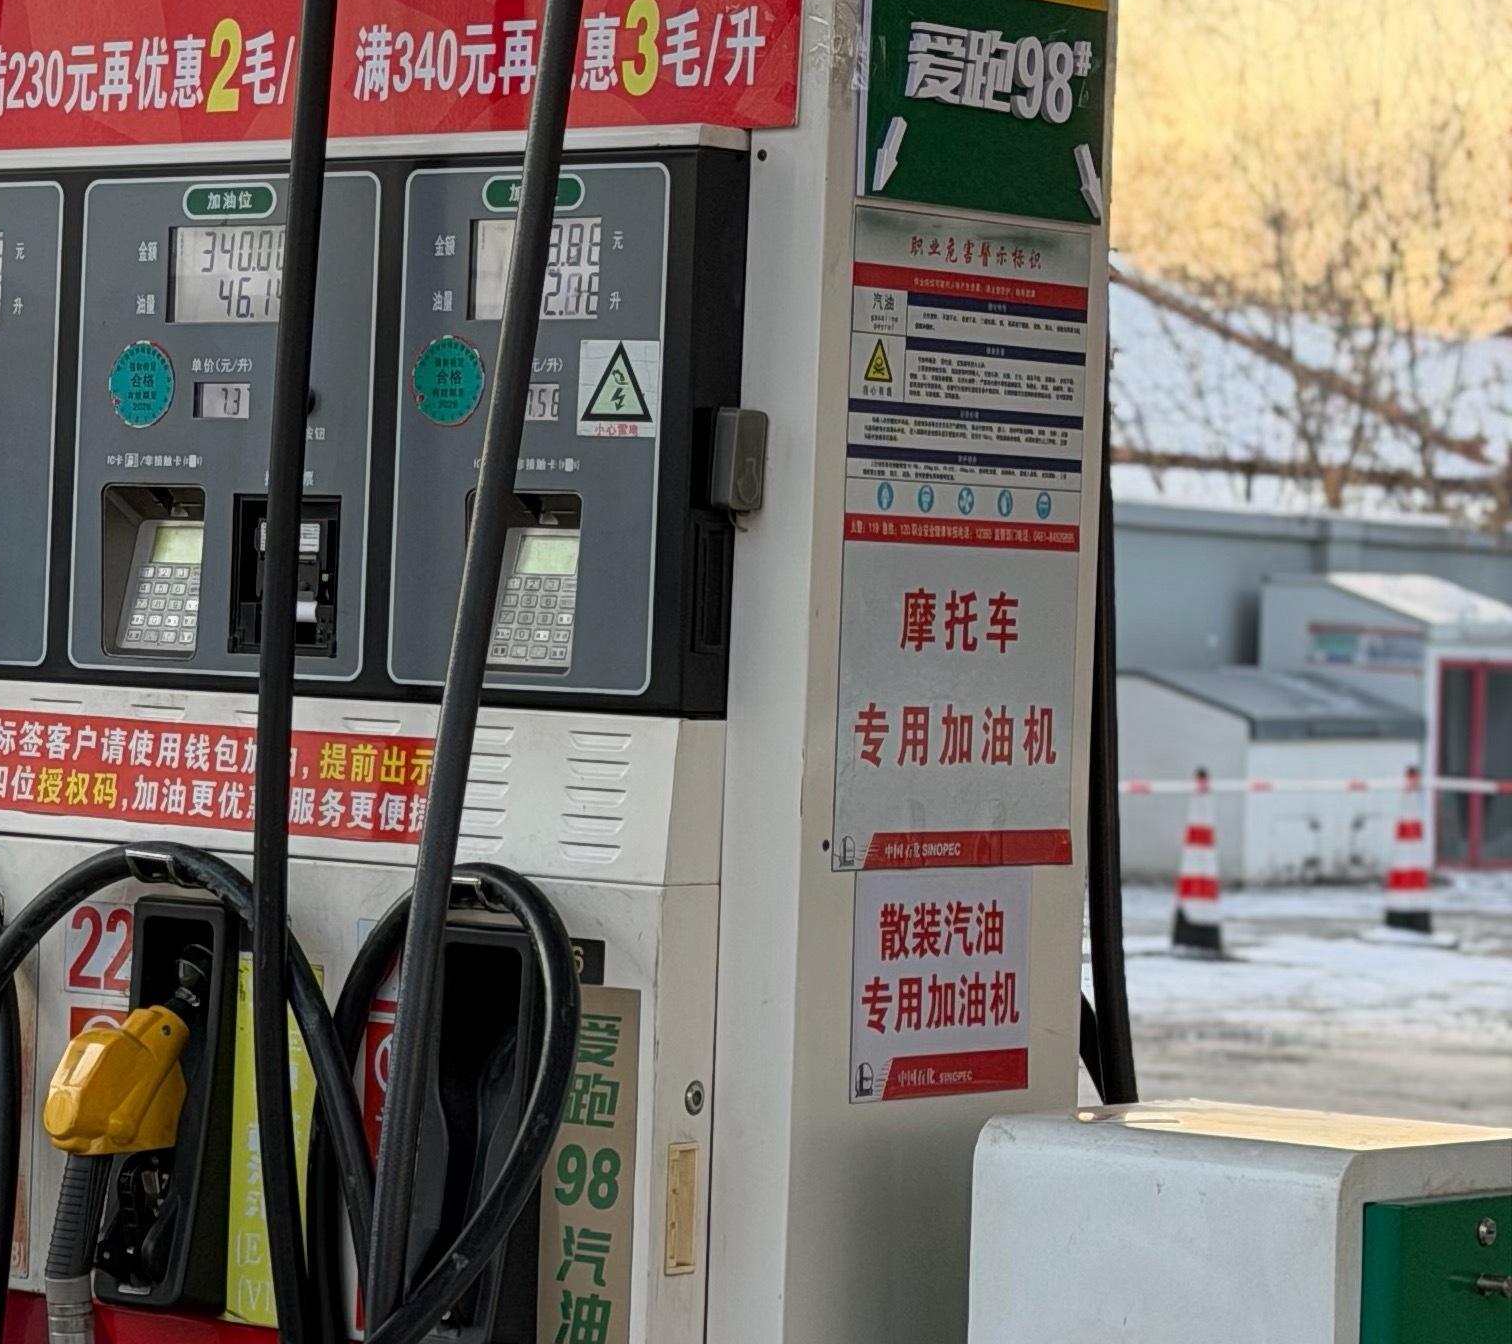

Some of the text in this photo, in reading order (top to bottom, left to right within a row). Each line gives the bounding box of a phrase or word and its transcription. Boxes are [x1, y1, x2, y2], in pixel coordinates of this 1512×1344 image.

[206, 192, 253, 210] 加油位
[612, 231, 624, 251] 元
[15, 243, 25, 261] 元
[12, 297, 24, 315] 升
[609, 292, 622, 311] 升
[872, 291, 895, 312] 汽油
[900, 587, 1020, 654] 摩托车
[854, 702, 1057, 768] 专用加油机
[922, 842, 962, 857] SINOPEC
[879, 899, 1006, 962] 散装汽油
[68, 905, 135, 992] 22
[861, 970, 1020, 1035] 专用加油机
